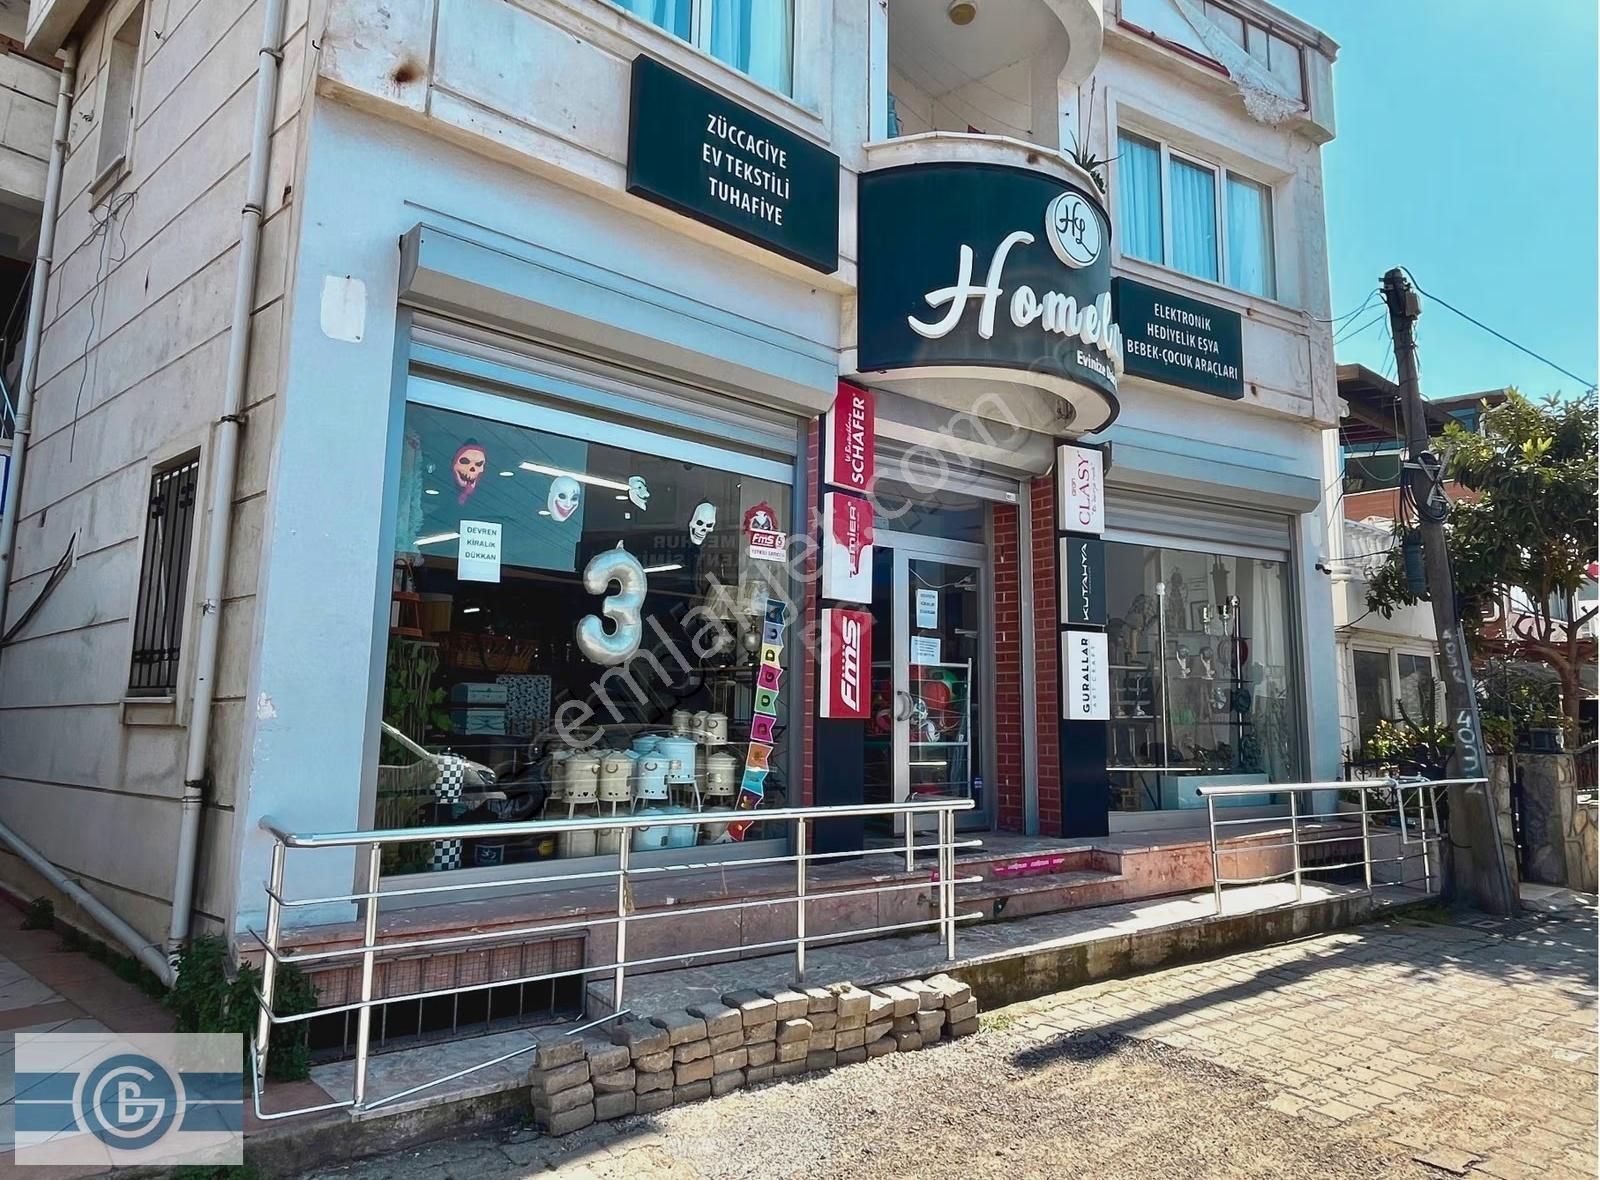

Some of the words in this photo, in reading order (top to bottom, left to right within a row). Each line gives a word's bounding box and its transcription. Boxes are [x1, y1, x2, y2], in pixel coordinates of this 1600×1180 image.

[706, 113, 788, 169] ZÜCCACİYE
[702, 142, 722, 167] EV
[725, 153, 790, 200] TEKSTİLİ
[708, 176, 783, 226] TUHAFİYE
[1147, 322, 1196, 348] HEDİYELİK
[1197, 336, 1220, 356] EŞYA
[1154, 303, 1212, 332] ELEKTRONİK
[1127, 338, 1193, 368] BEBEK-ÇOCUK
[1194, 357, 1239, 381] ARAÇLARI
[851, 396, 865, 485] SCHAFER
[1077, 454, 1091, 525] CLASY
[466, 526, 497, 536] DEVREN
[465, 551, 497, 561] DÜKKAN
